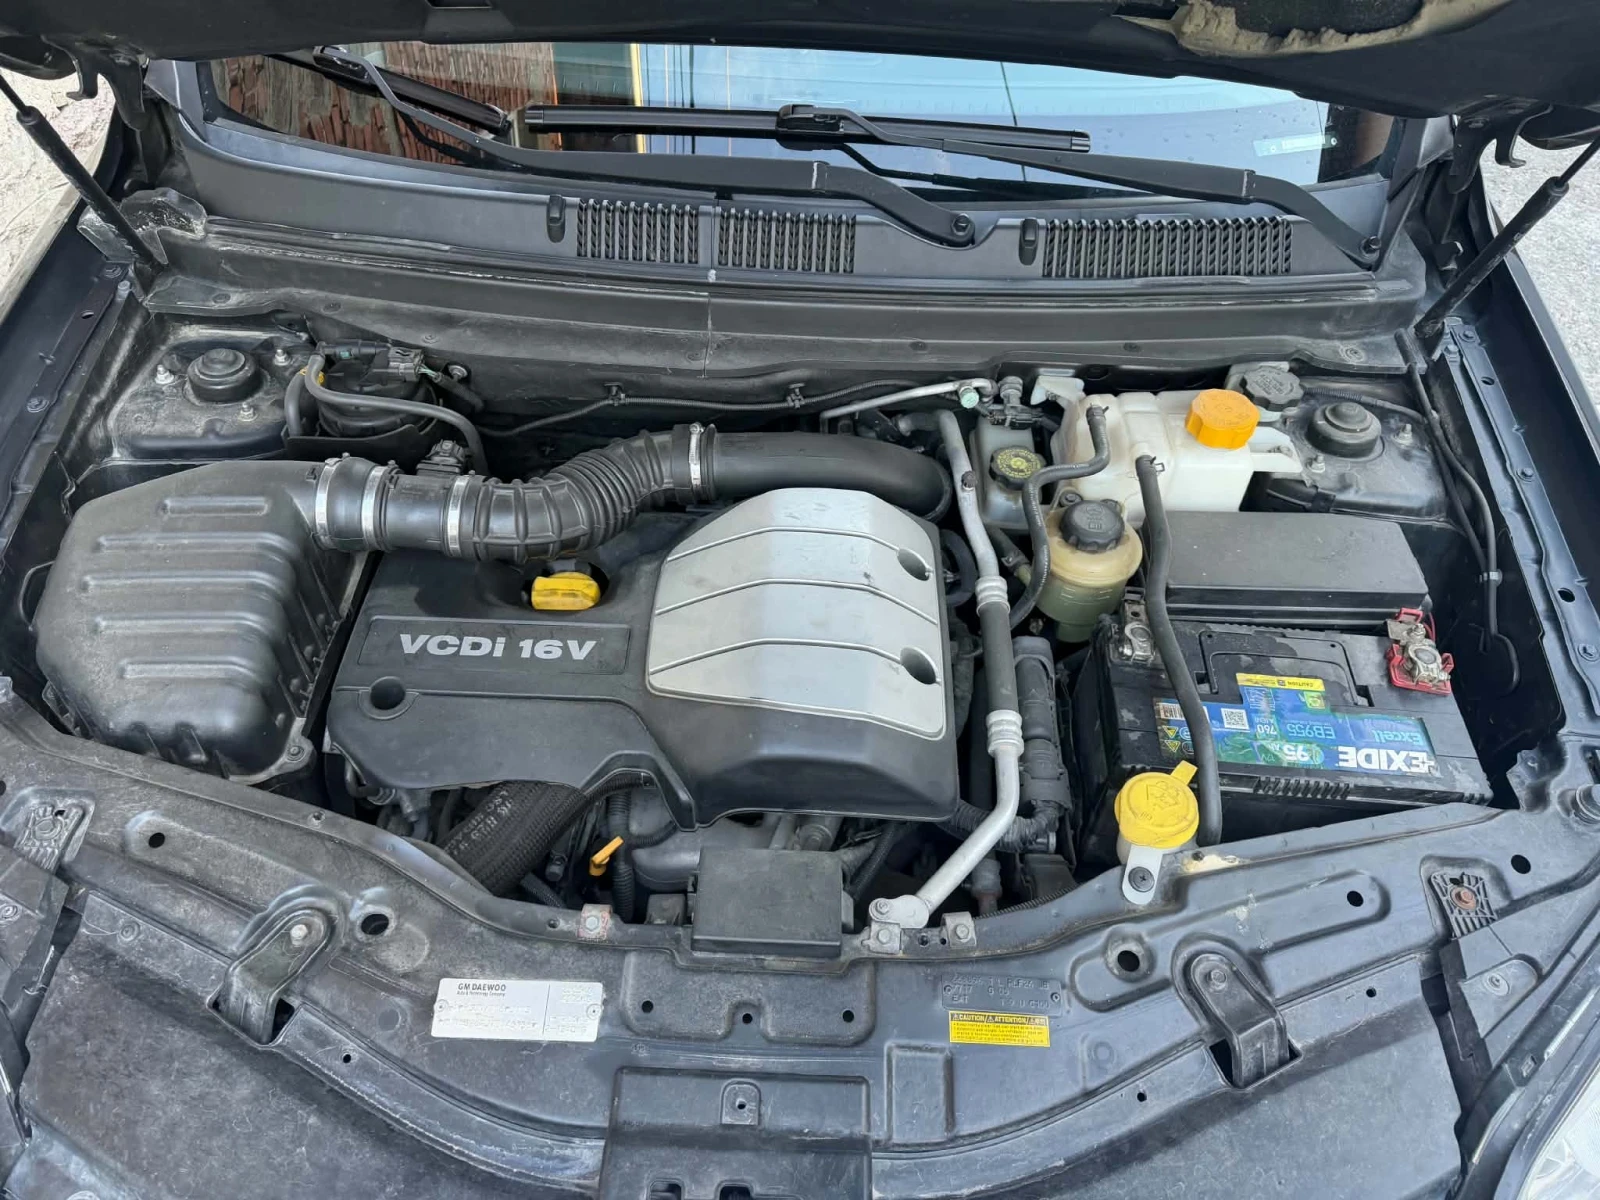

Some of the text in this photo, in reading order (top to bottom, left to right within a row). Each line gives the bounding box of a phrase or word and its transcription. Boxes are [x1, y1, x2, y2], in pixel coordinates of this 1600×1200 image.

[400, 634, 597, 660] VCDi 16V
[1257, 725, 1277, 734] 760
[1286, 723, 1336, 739] EB955
[1372, 730, 1423, 745] Excell
[1283, 745, 1310, 760] 95
[1338, 746, 1434, 773] EXIDE
[458, 983, 506, 991] GM DAEWOO
[994, 1016, 1027, 1024] ATTENTION
